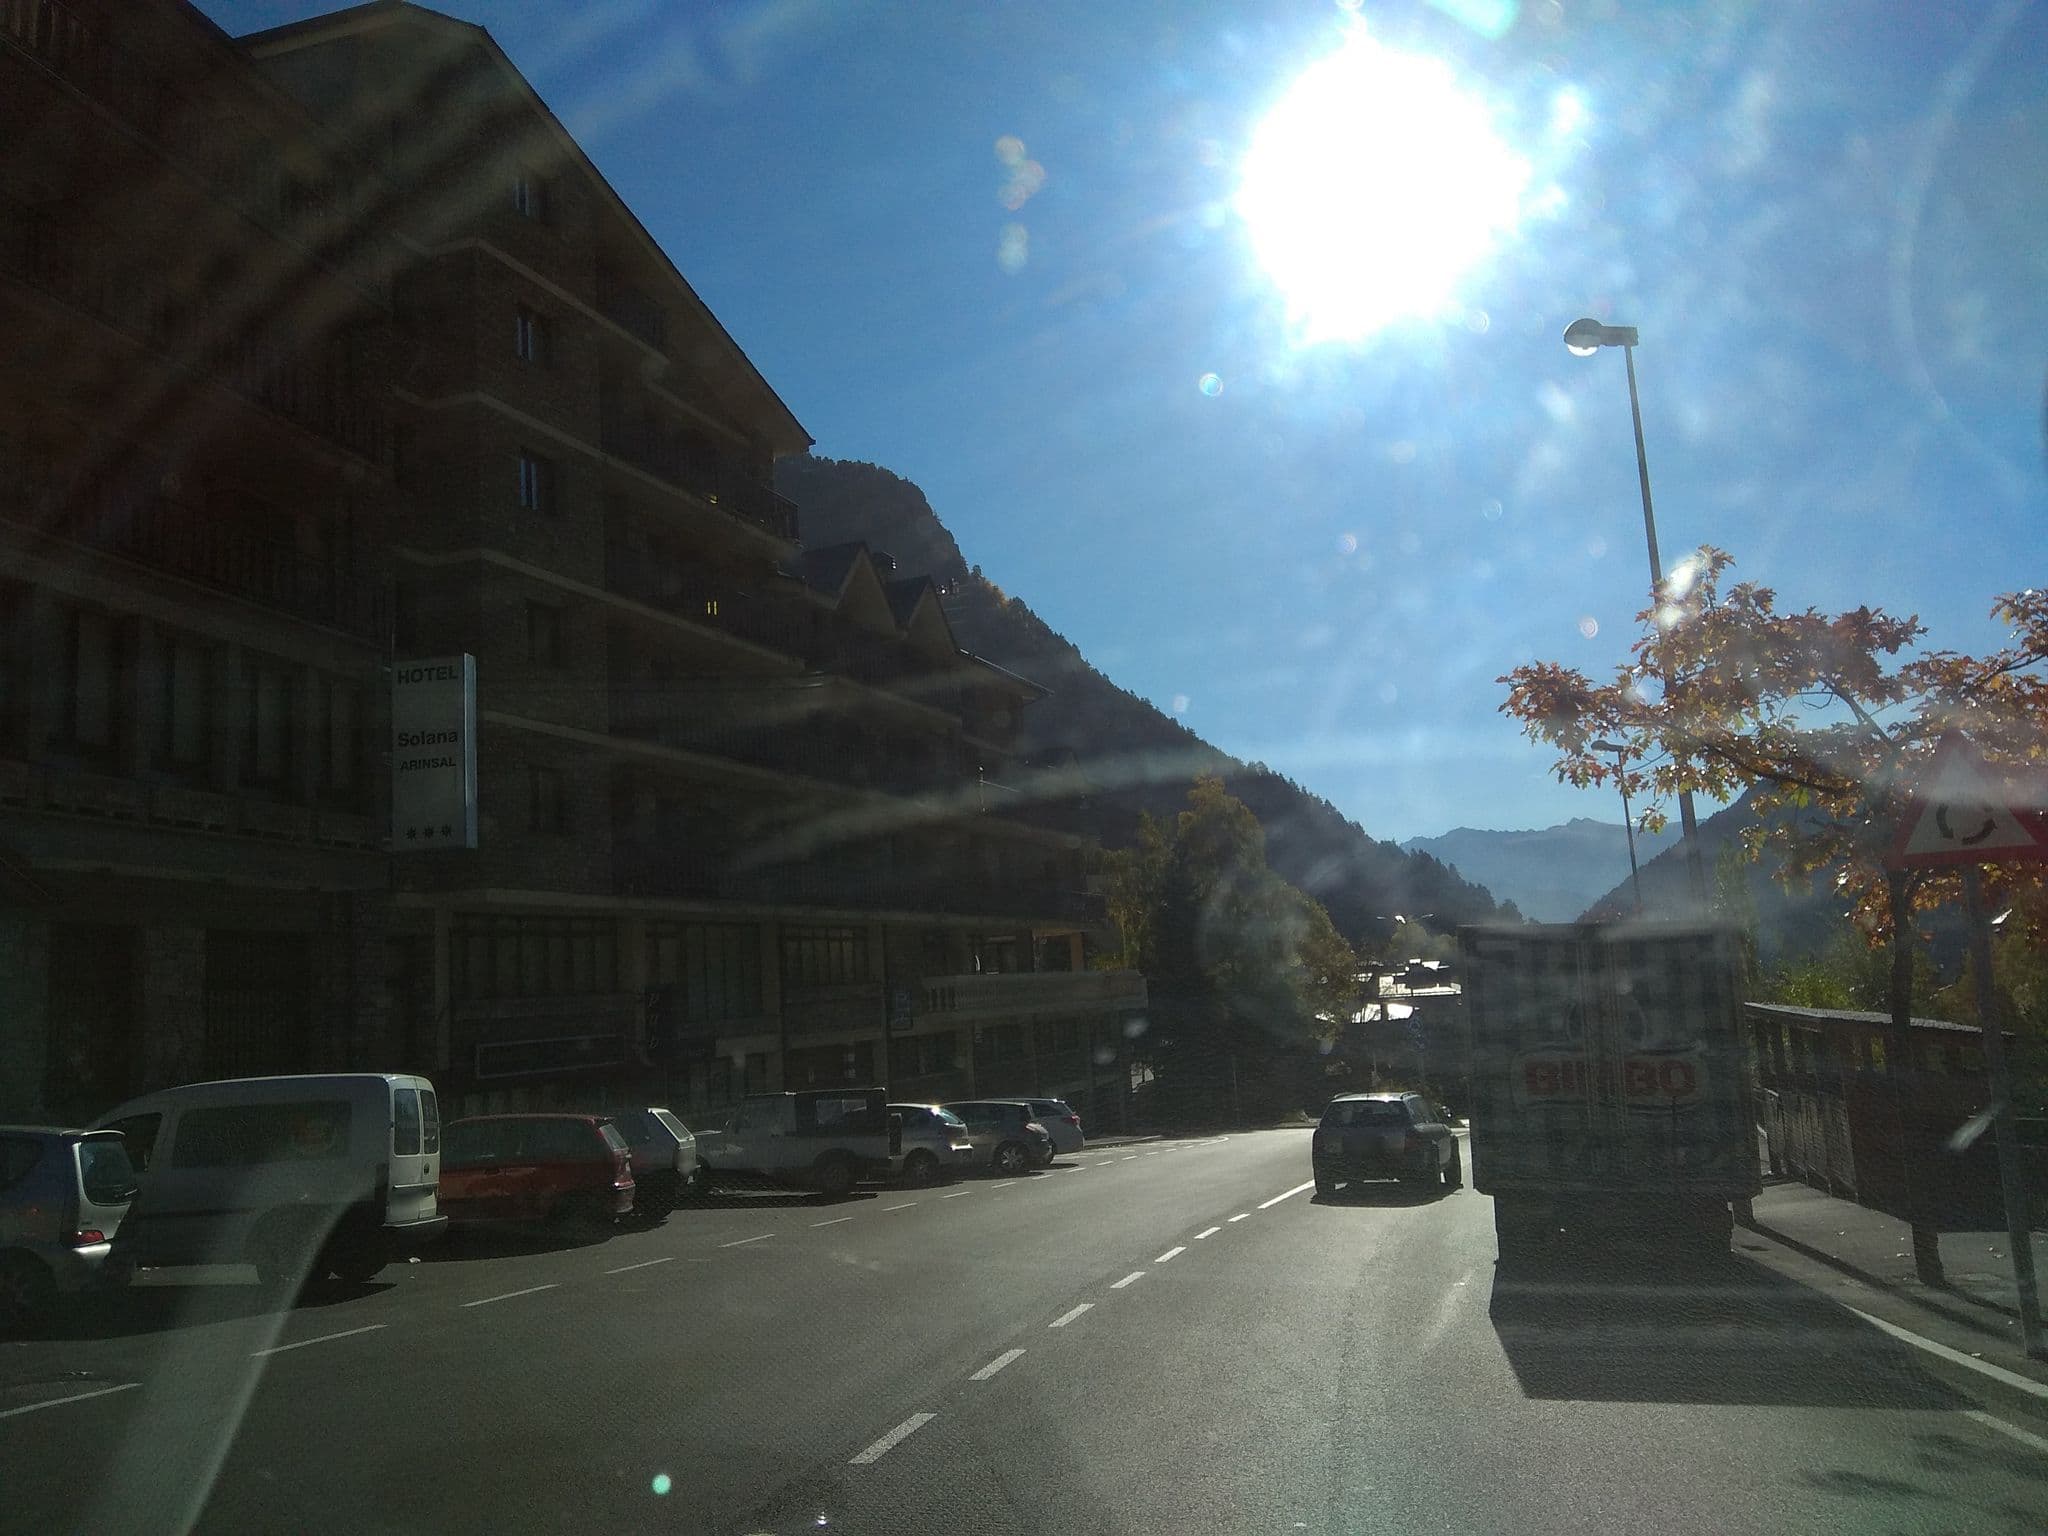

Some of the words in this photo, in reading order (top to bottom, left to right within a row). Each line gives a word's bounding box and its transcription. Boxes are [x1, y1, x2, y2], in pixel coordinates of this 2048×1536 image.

[397, 665, 459, 685] HOTEL
[398, 730, 458, 748] Solana
[400, 756, 457, 772] ARINSAL
